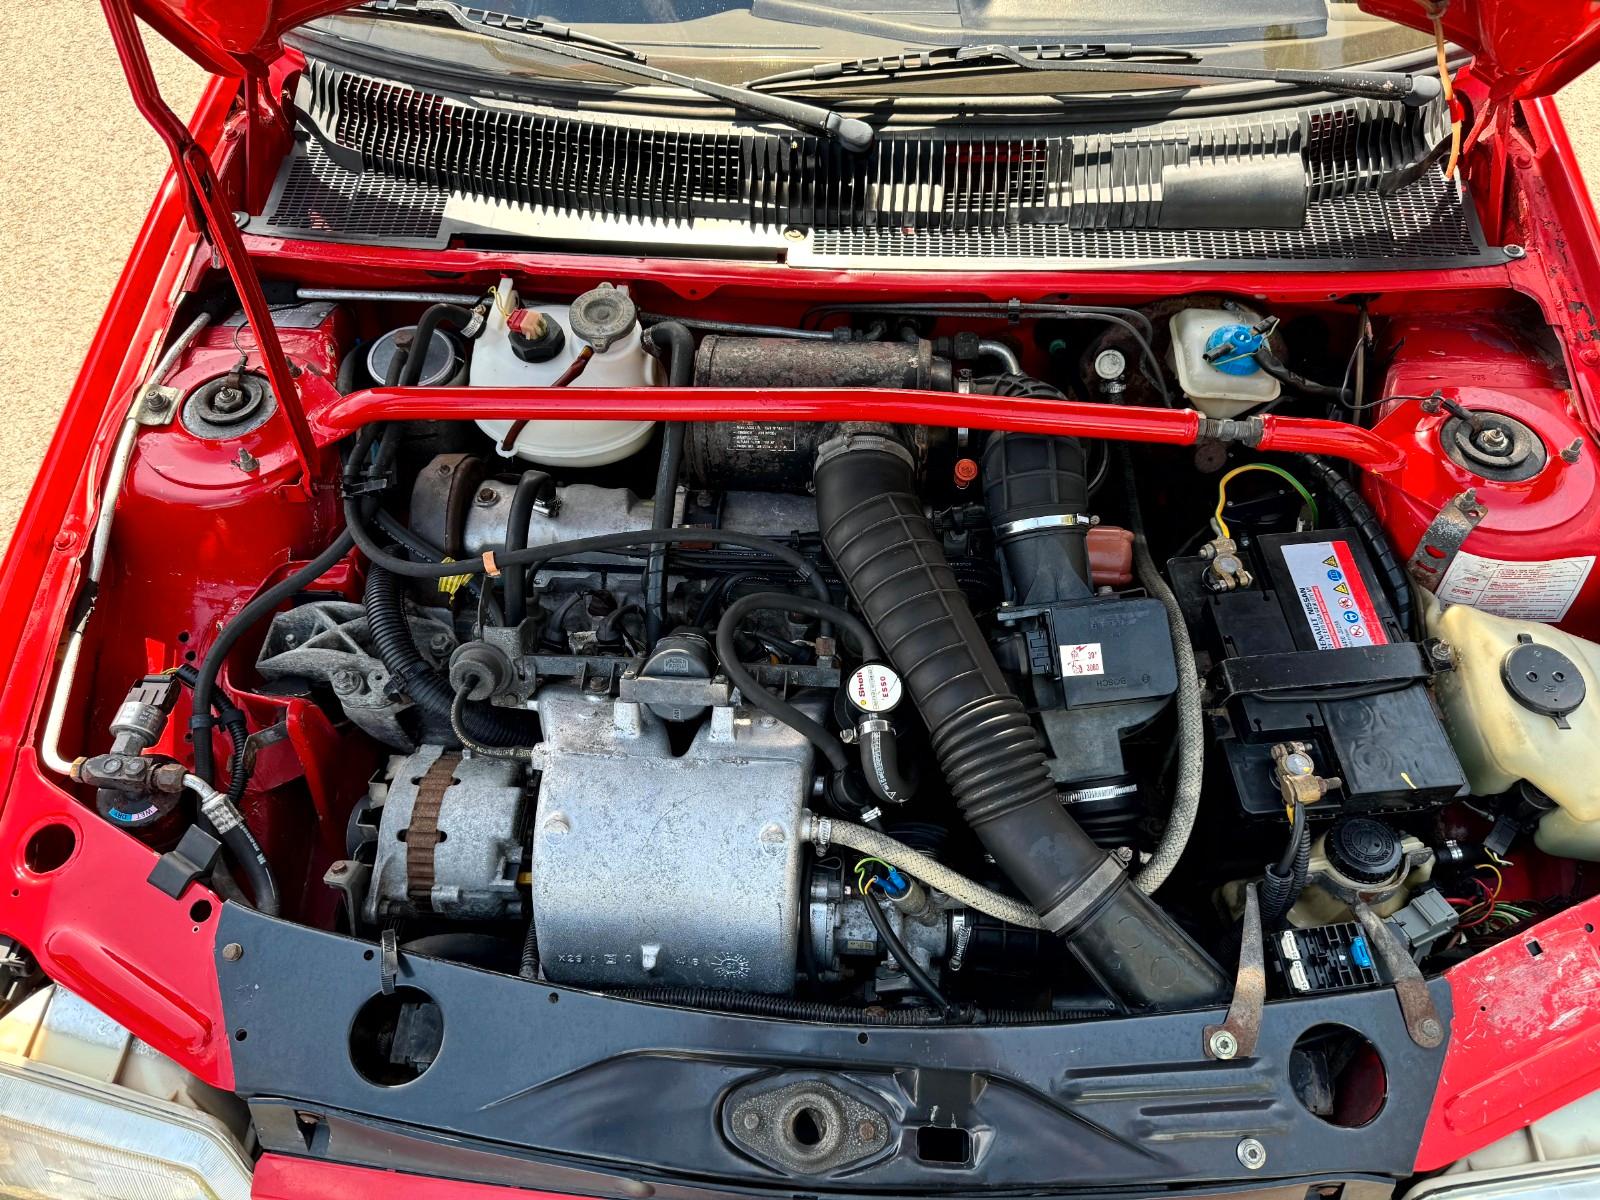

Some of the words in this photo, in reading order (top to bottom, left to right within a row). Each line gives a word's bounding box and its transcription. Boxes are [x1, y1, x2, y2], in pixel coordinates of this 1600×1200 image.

[1300, 587, 1314, 615] NISSAN
[1311, 618, 1327, 650] RENAULT
[880, 676, 888, 697] ESSO
[1096, 677, 1127, 686] BOSCH
